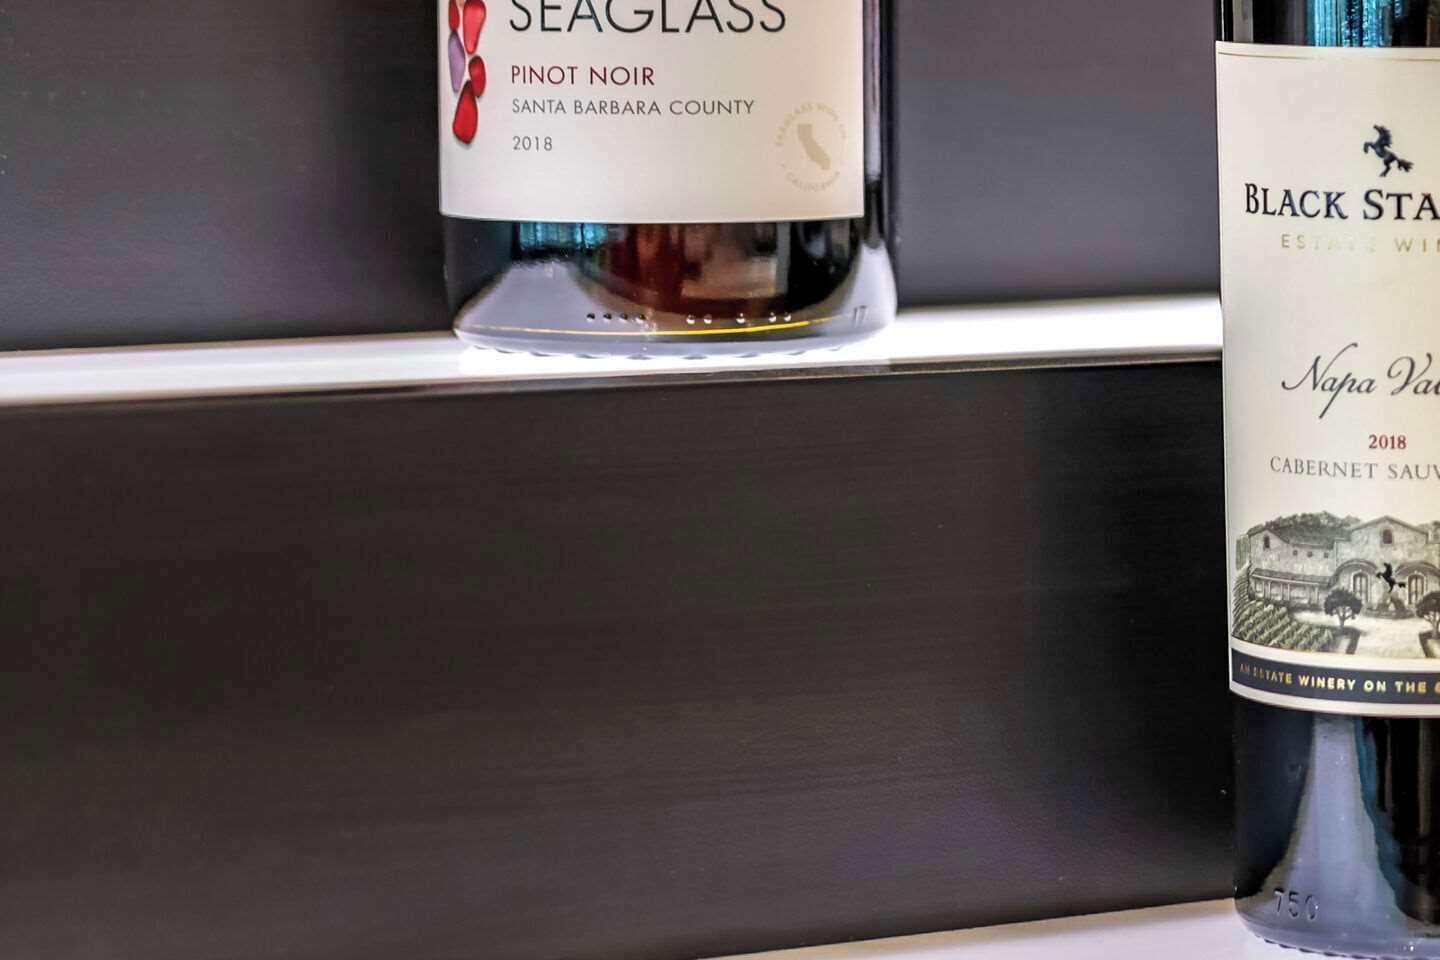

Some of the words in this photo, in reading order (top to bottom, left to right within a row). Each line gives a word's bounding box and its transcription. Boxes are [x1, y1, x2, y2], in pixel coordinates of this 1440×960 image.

[511, 65, 579, 86] PINOT
[588, 65, 656, 86] NOIR
[511, 98, 567, 115] SANTA
[573, 99, 661, 116] BARBARA
[669, 99, 755, 116] COUNTY
[512, 136, 553, 152] 2018
[1244, 182, 1349, 220] BLACK
[1281, 342, 1378, 420] Napa
[1367, 434, 1408, 450] 2018
[1269, 456, 1379, 480] CABERNET
[1298, 674, 1356, 691] WINERY
[1363, 679, 1387, 693] ON
[1394, 680, 1427, 694] THE
